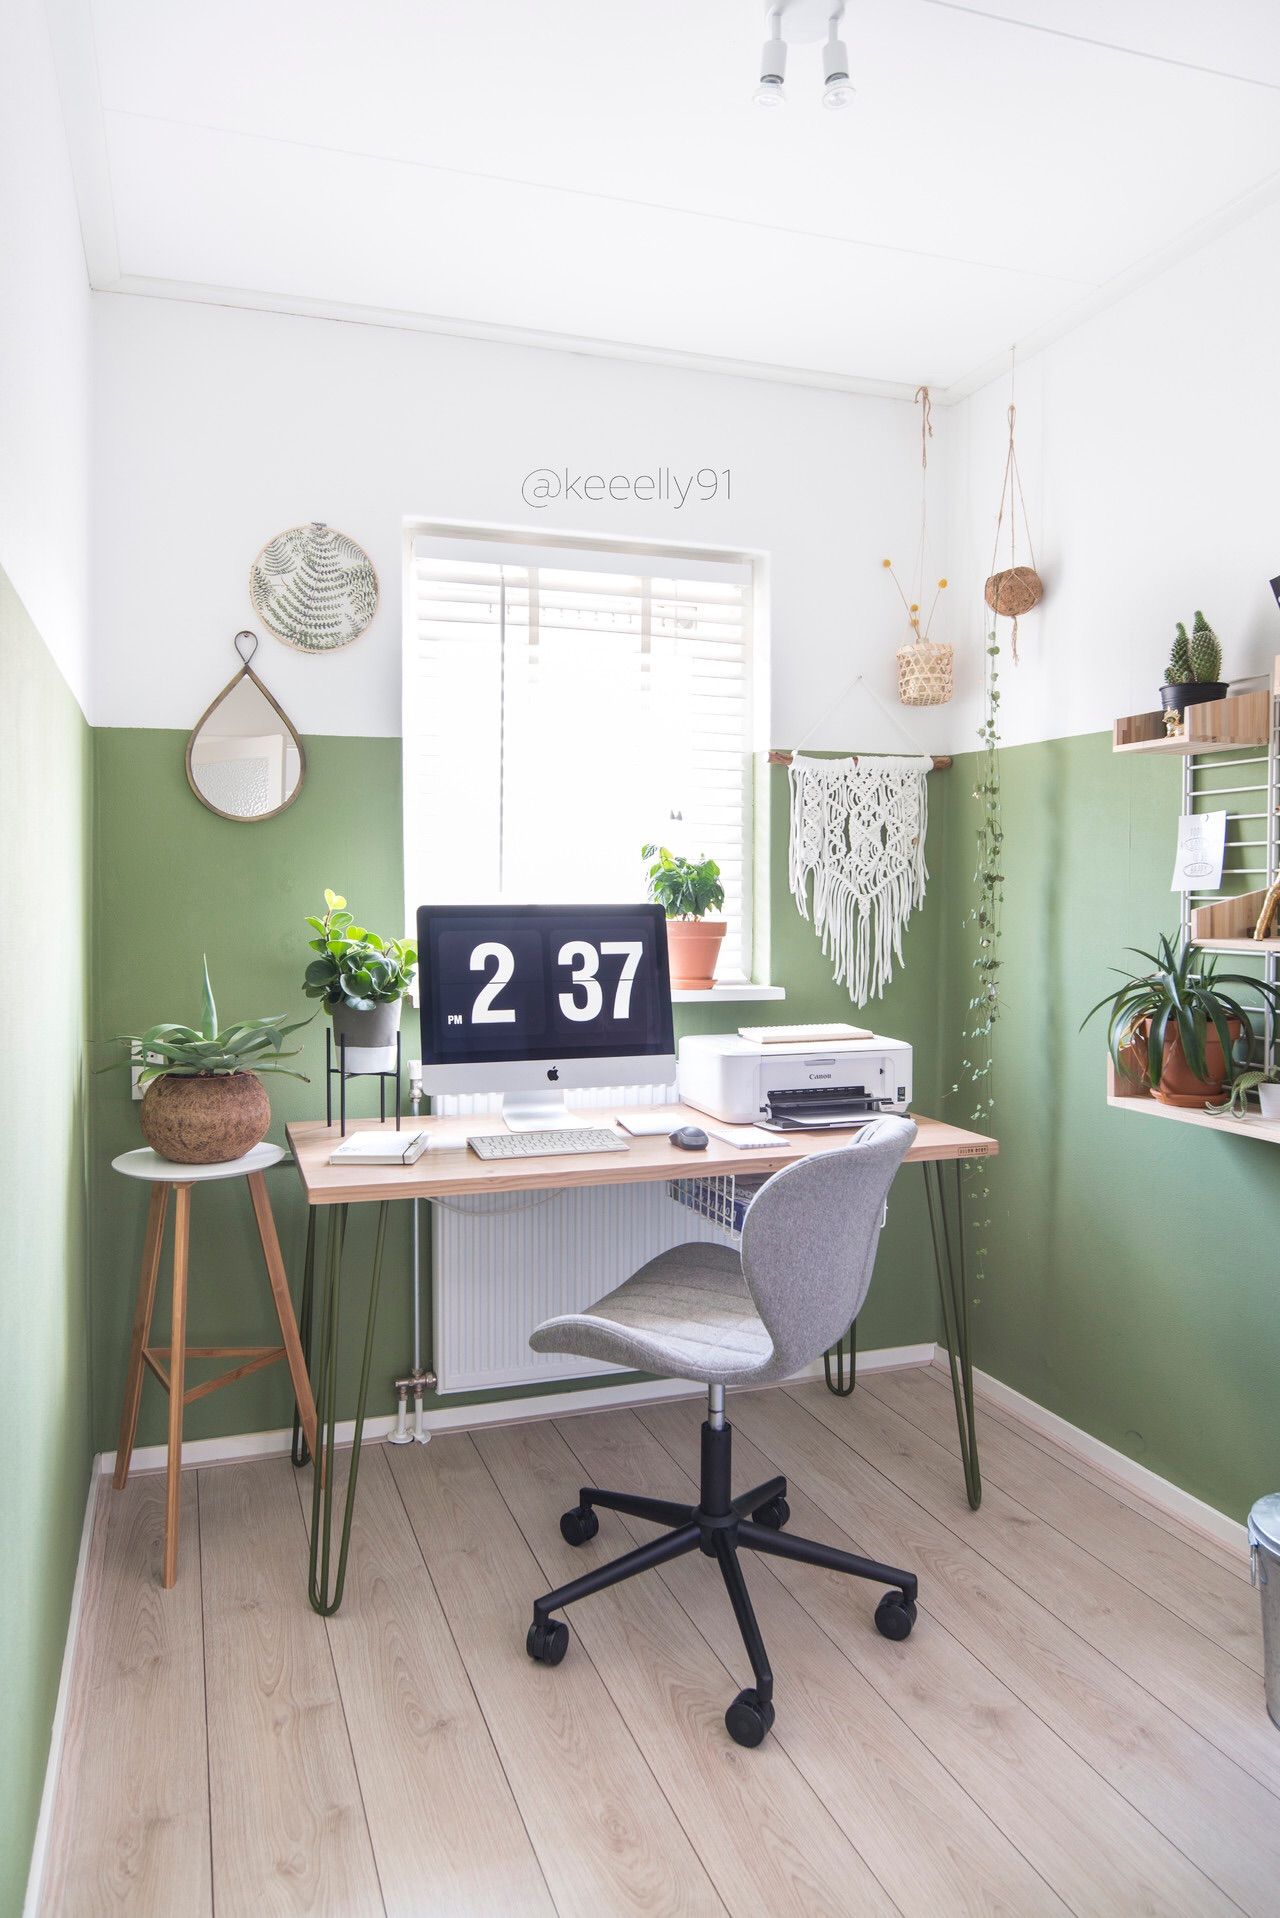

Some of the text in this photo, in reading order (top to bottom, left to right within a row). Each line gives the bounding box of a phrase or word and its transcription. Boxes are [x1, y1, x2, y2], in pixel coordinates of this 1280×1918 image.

[469, 940, 643, 1024] 2 37
[447, 1014, 463, 1025] PM
[808, 1073, 832, 1081] Canon
